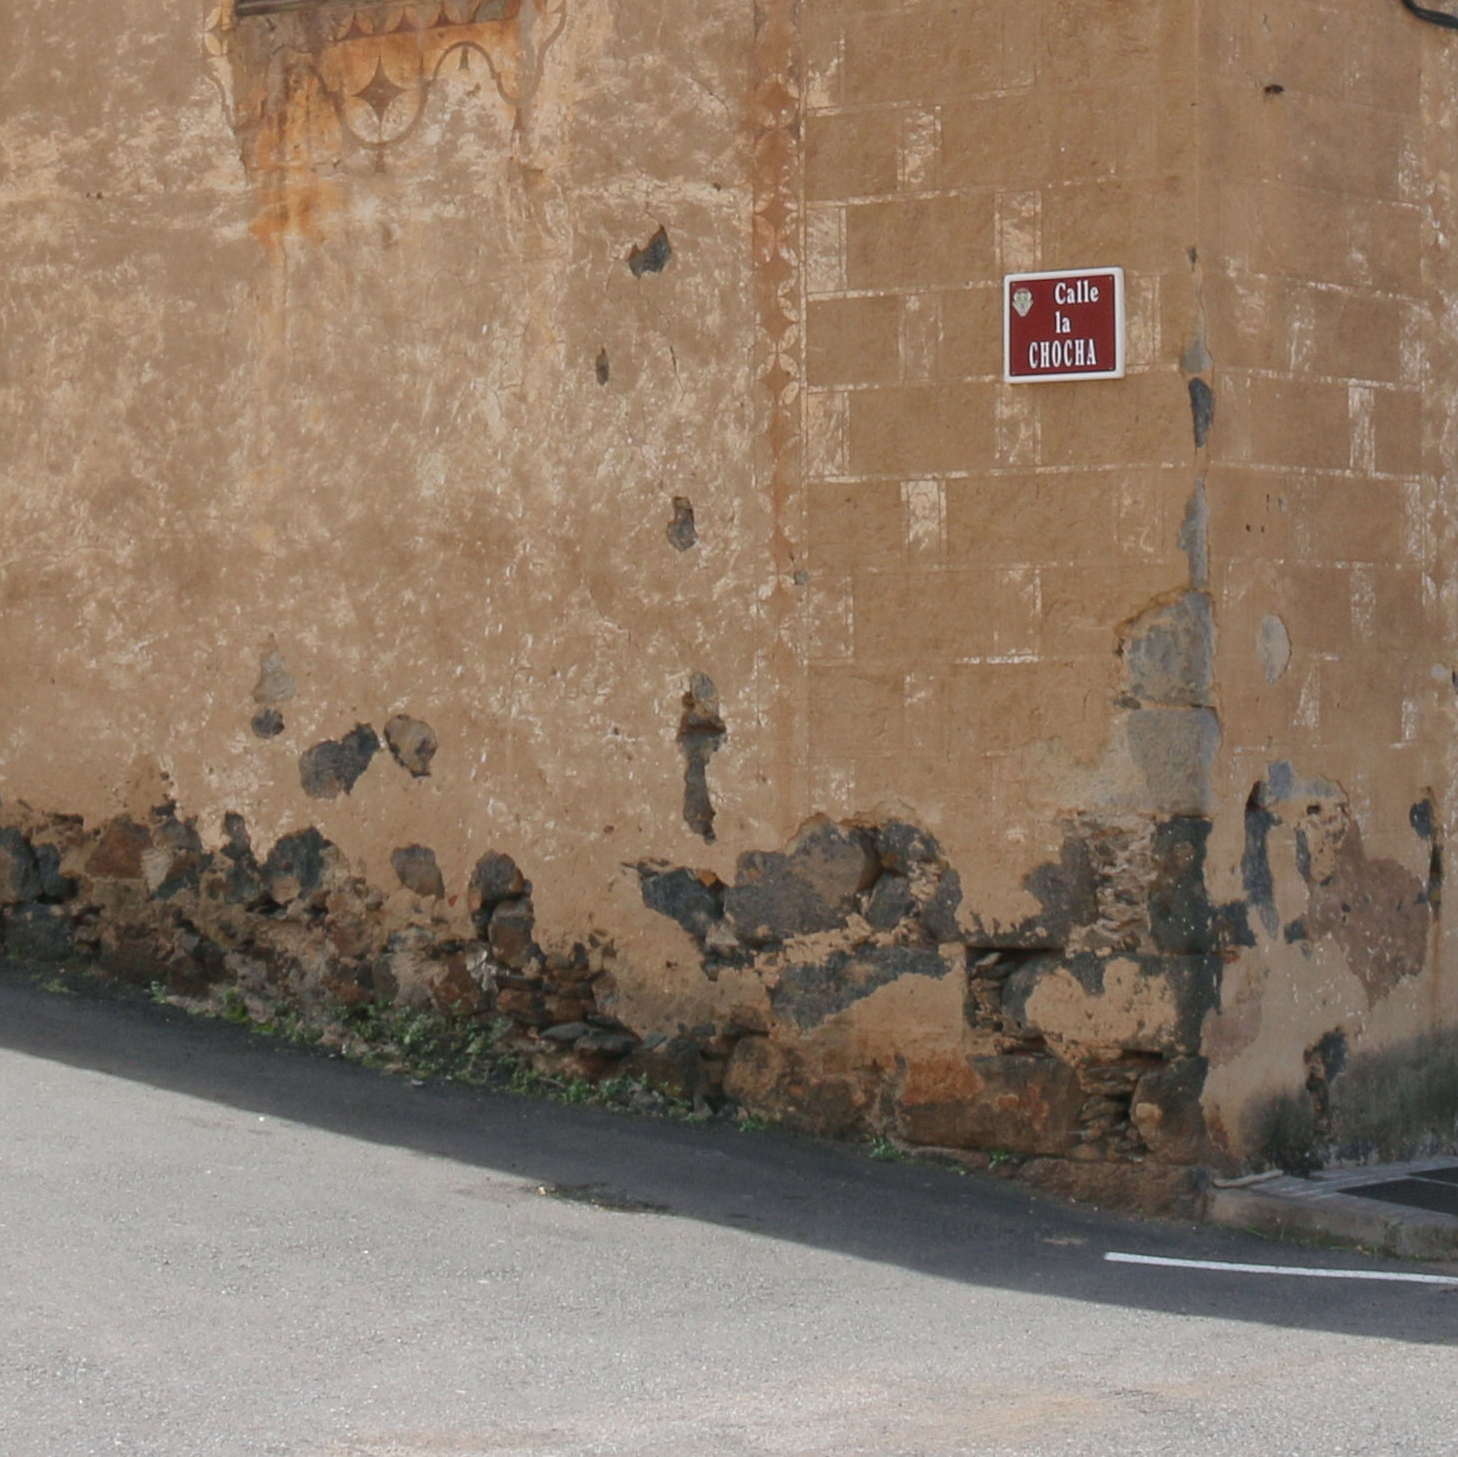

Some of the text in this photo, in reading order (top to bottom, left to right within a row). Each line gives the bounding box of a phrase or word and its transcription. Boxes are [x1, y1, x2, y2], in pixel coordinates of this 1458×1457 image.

[1054, 280, 1099, 305] Calle
[1055, 310, 1071, 334] la
[1028, 338, 1097, 369] CHOCHA
